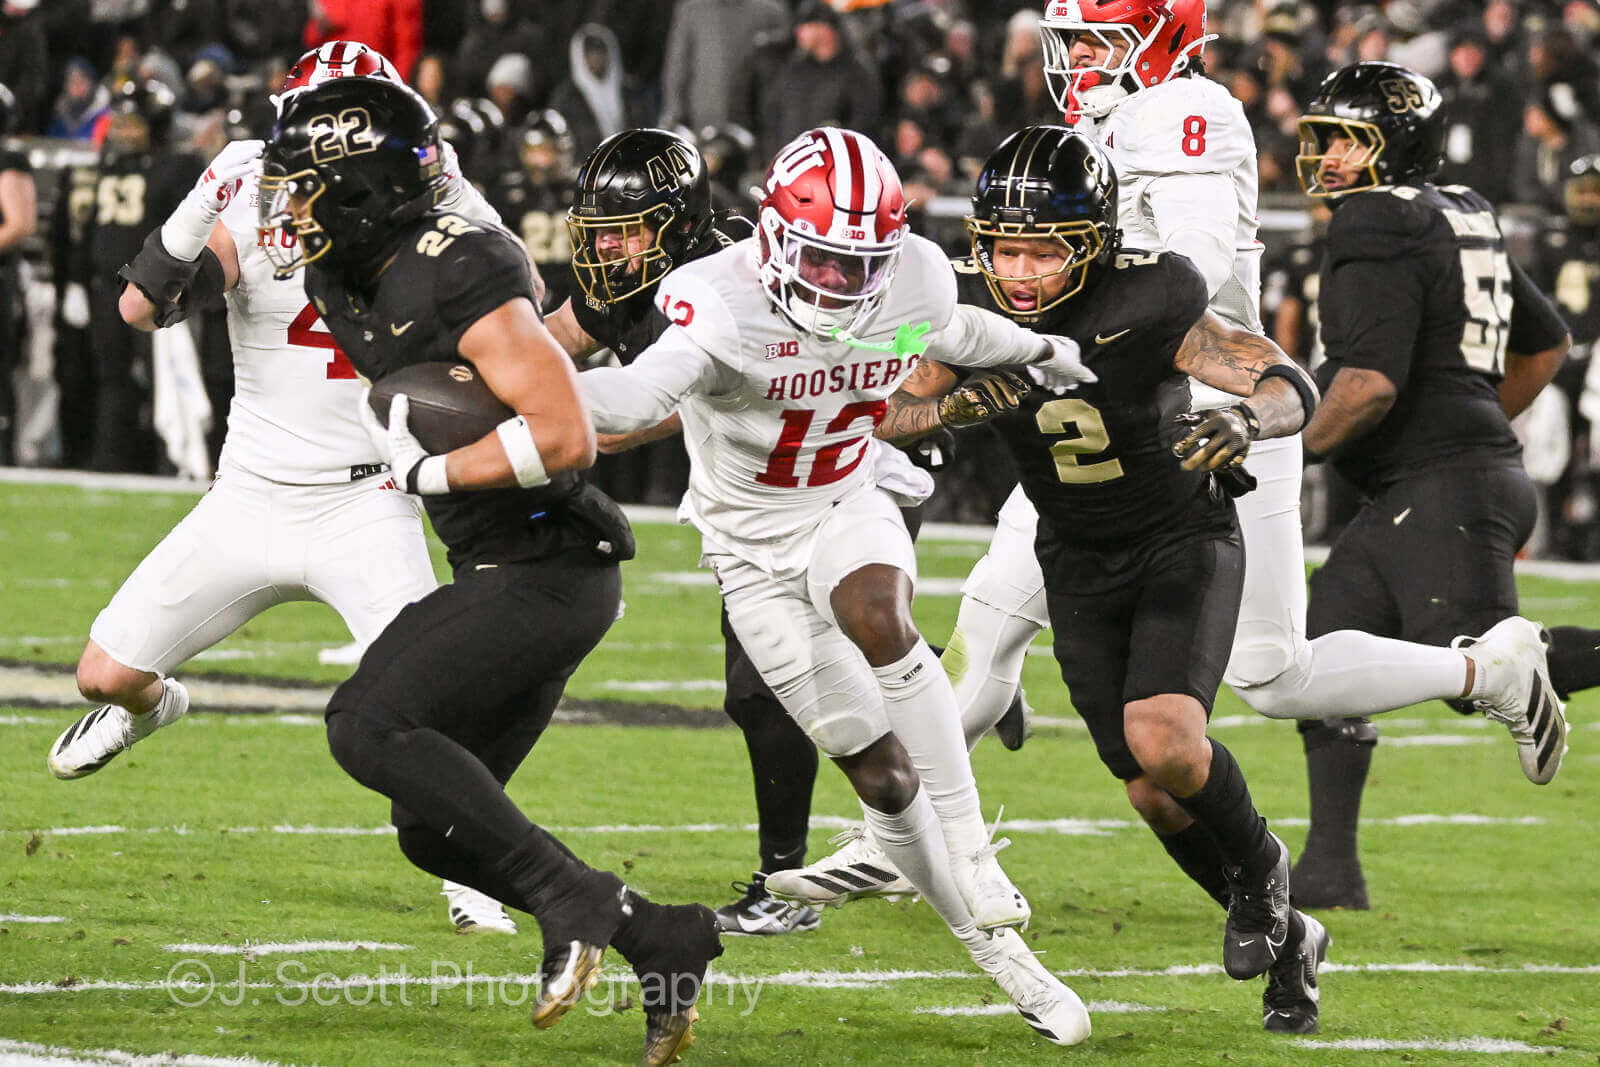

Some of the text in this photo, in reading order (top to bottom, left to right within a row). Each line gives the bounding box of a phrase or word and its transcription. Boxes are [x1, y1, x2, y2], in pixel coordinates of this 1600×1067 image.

[308, 107, 376, 164] 22
[1181, 115, 1207, 157] 8
[646, 146, 698, 193] 44
[416, 215, 482, 257] 22
[754, 399, 888, 488] 12
[1035, 398, 1124, 484] 2
